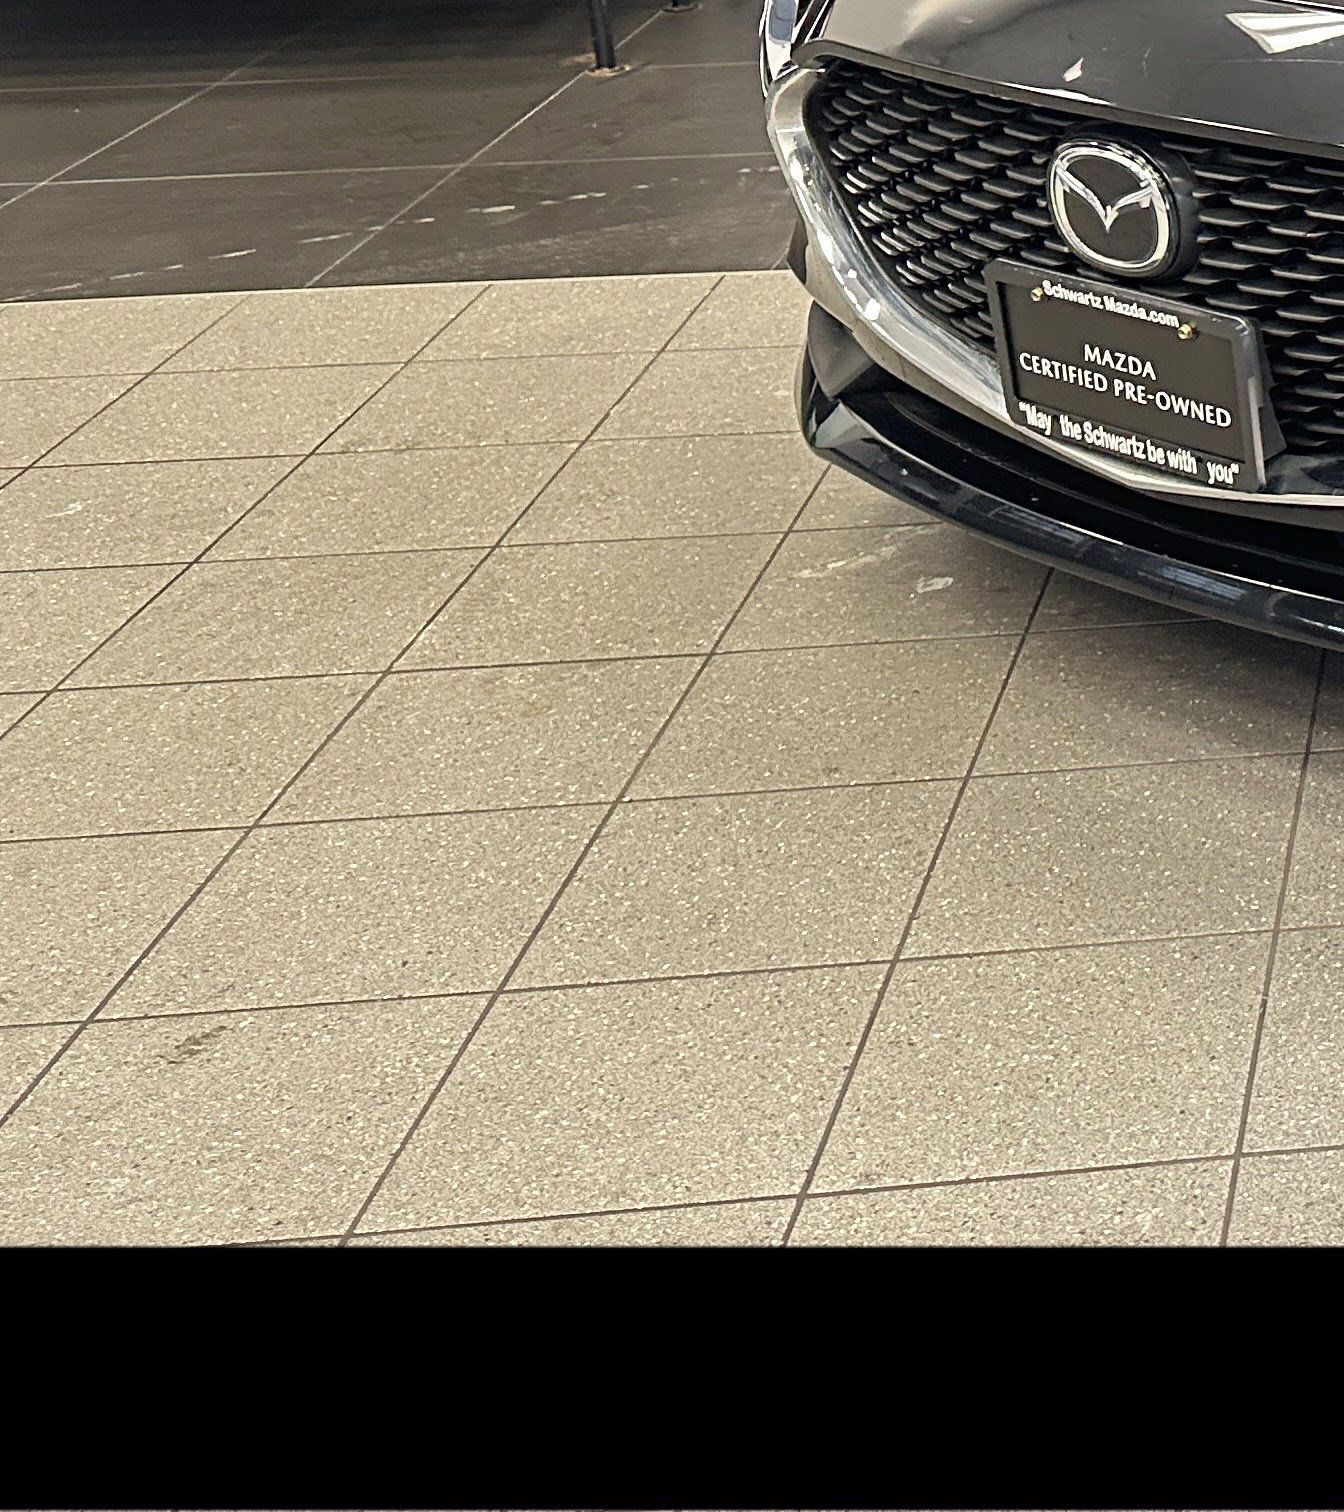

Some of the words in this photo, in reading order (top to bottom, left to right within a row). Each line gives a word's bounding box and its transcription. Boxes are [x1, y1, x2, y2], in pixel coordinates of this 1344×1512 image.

[1019, 352, 1108, 392] CERTIFIED
[1113, 378, 1232, 427] PRE-OWNED
[1084, 344, 1157, 381] MAZDA
[1058, 414, 1082, 441] the
[1082, 421, 1147, 460] Schwartz
[1147, 440, 1166, 465] be
[1166, 448, 1198, 474] with
